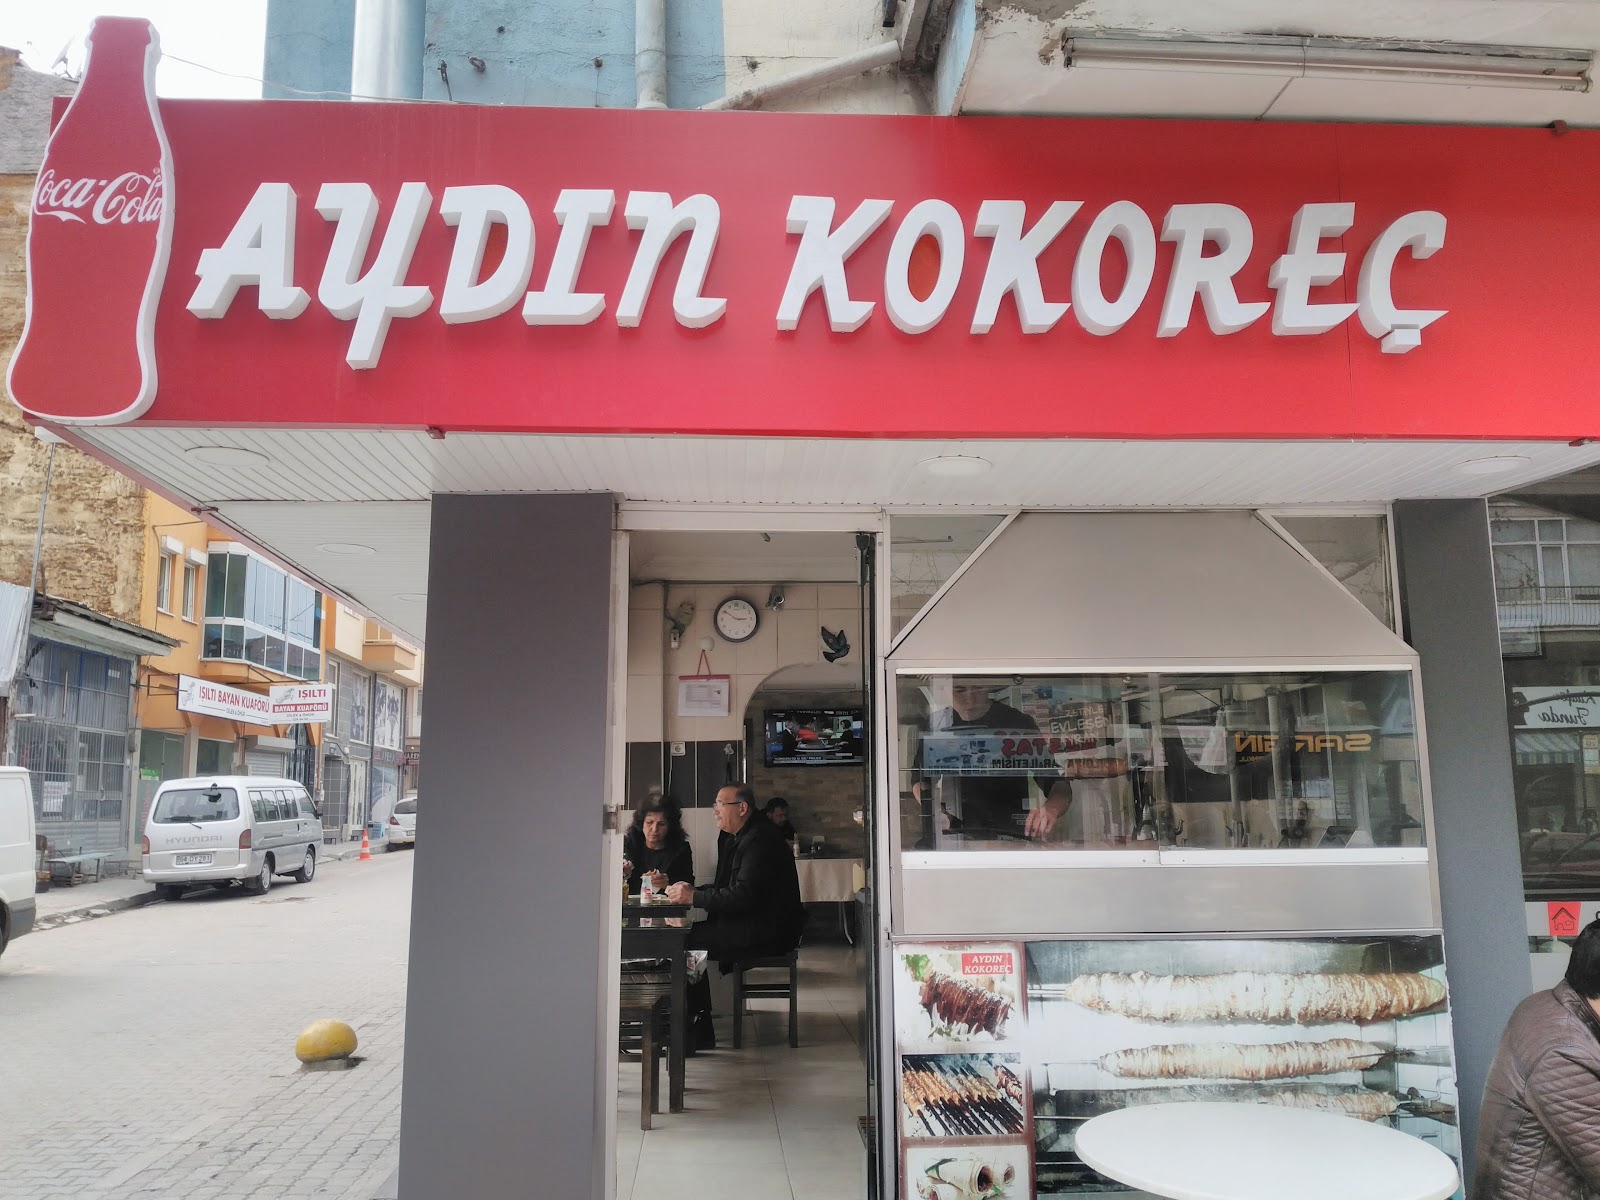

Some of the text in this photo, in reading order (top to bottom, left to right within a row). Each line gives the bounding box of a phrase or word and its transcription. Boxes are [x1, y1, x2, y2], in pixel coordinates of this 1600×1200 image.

[34, 169, 163, 225] Coca-Cola
[186, 182, 1449, 370] AYDIN KOKOREÇ
[218, 690, 240, 706] BAYAN
[298, 689, 327, 700] IŞILTI
[274, 704, 296, 712] BAYAN
[165, 835, 223, 845] HYUNDAI
[971, 955, 1003, 964] AYDIN
[964, 965, 1012, 975] KOKOREÇ
